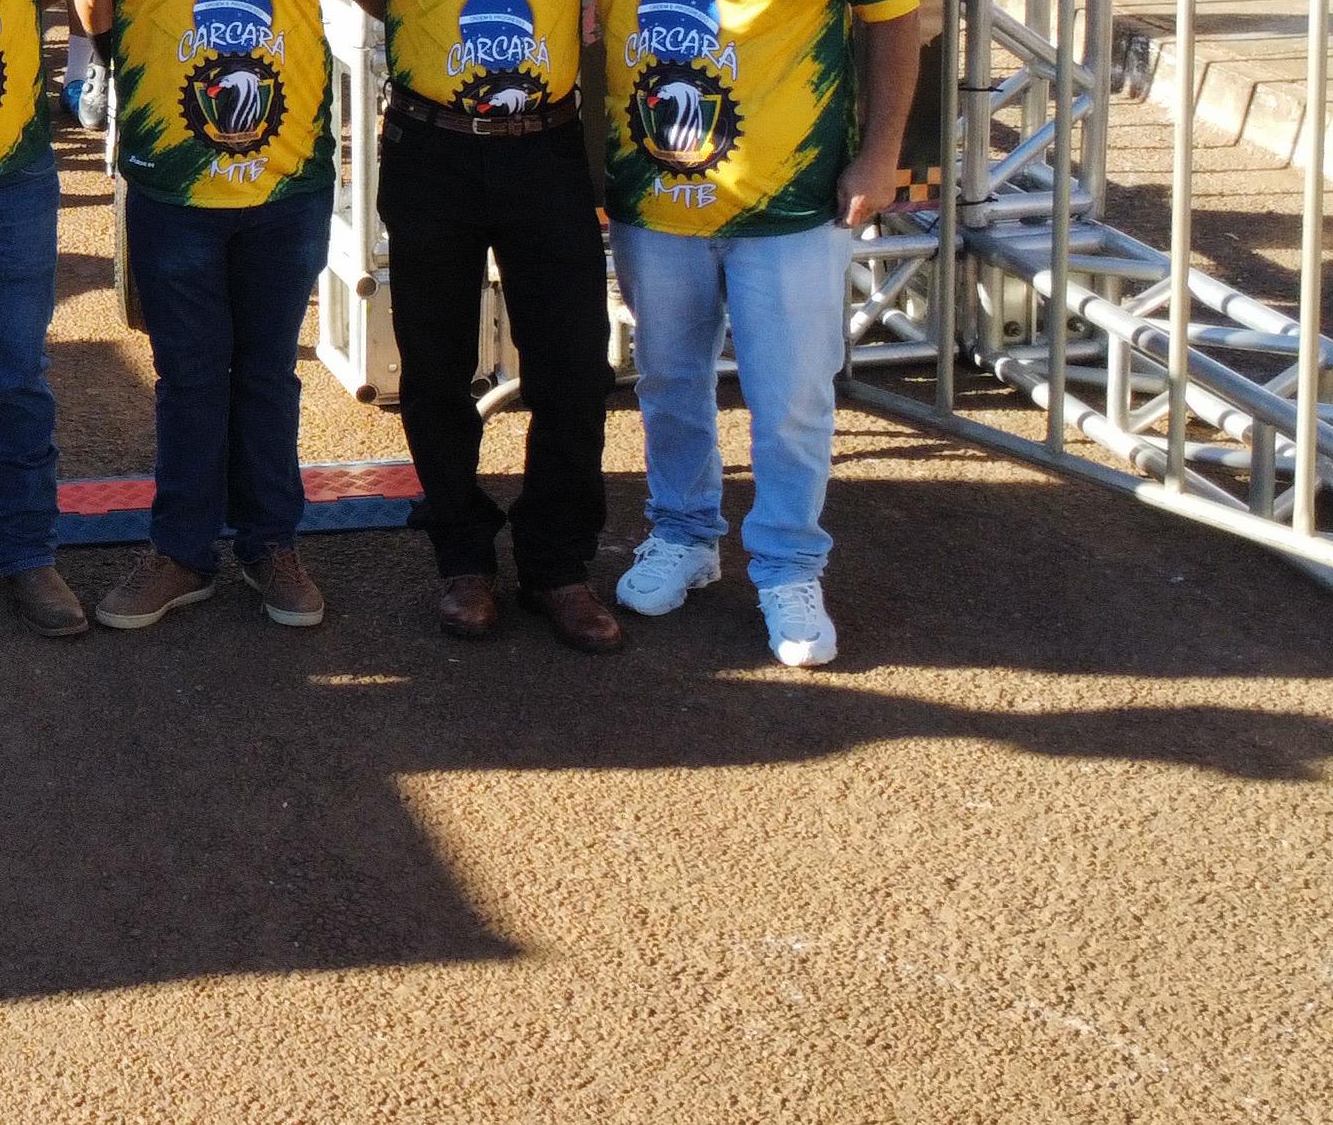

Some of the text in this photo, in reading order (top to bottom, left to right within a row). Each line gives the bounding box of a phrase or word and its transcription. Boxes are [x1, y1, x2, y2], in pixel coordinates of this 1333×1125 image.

[178, 21, 285, 66] CARCARÁ
[447, 35, 550, 76] CARCARÁ
[625, 27, 738, 80] CARCARÁ
[210, 157, 269, 183] MTB
[654, 177, 716, 208] MTB
